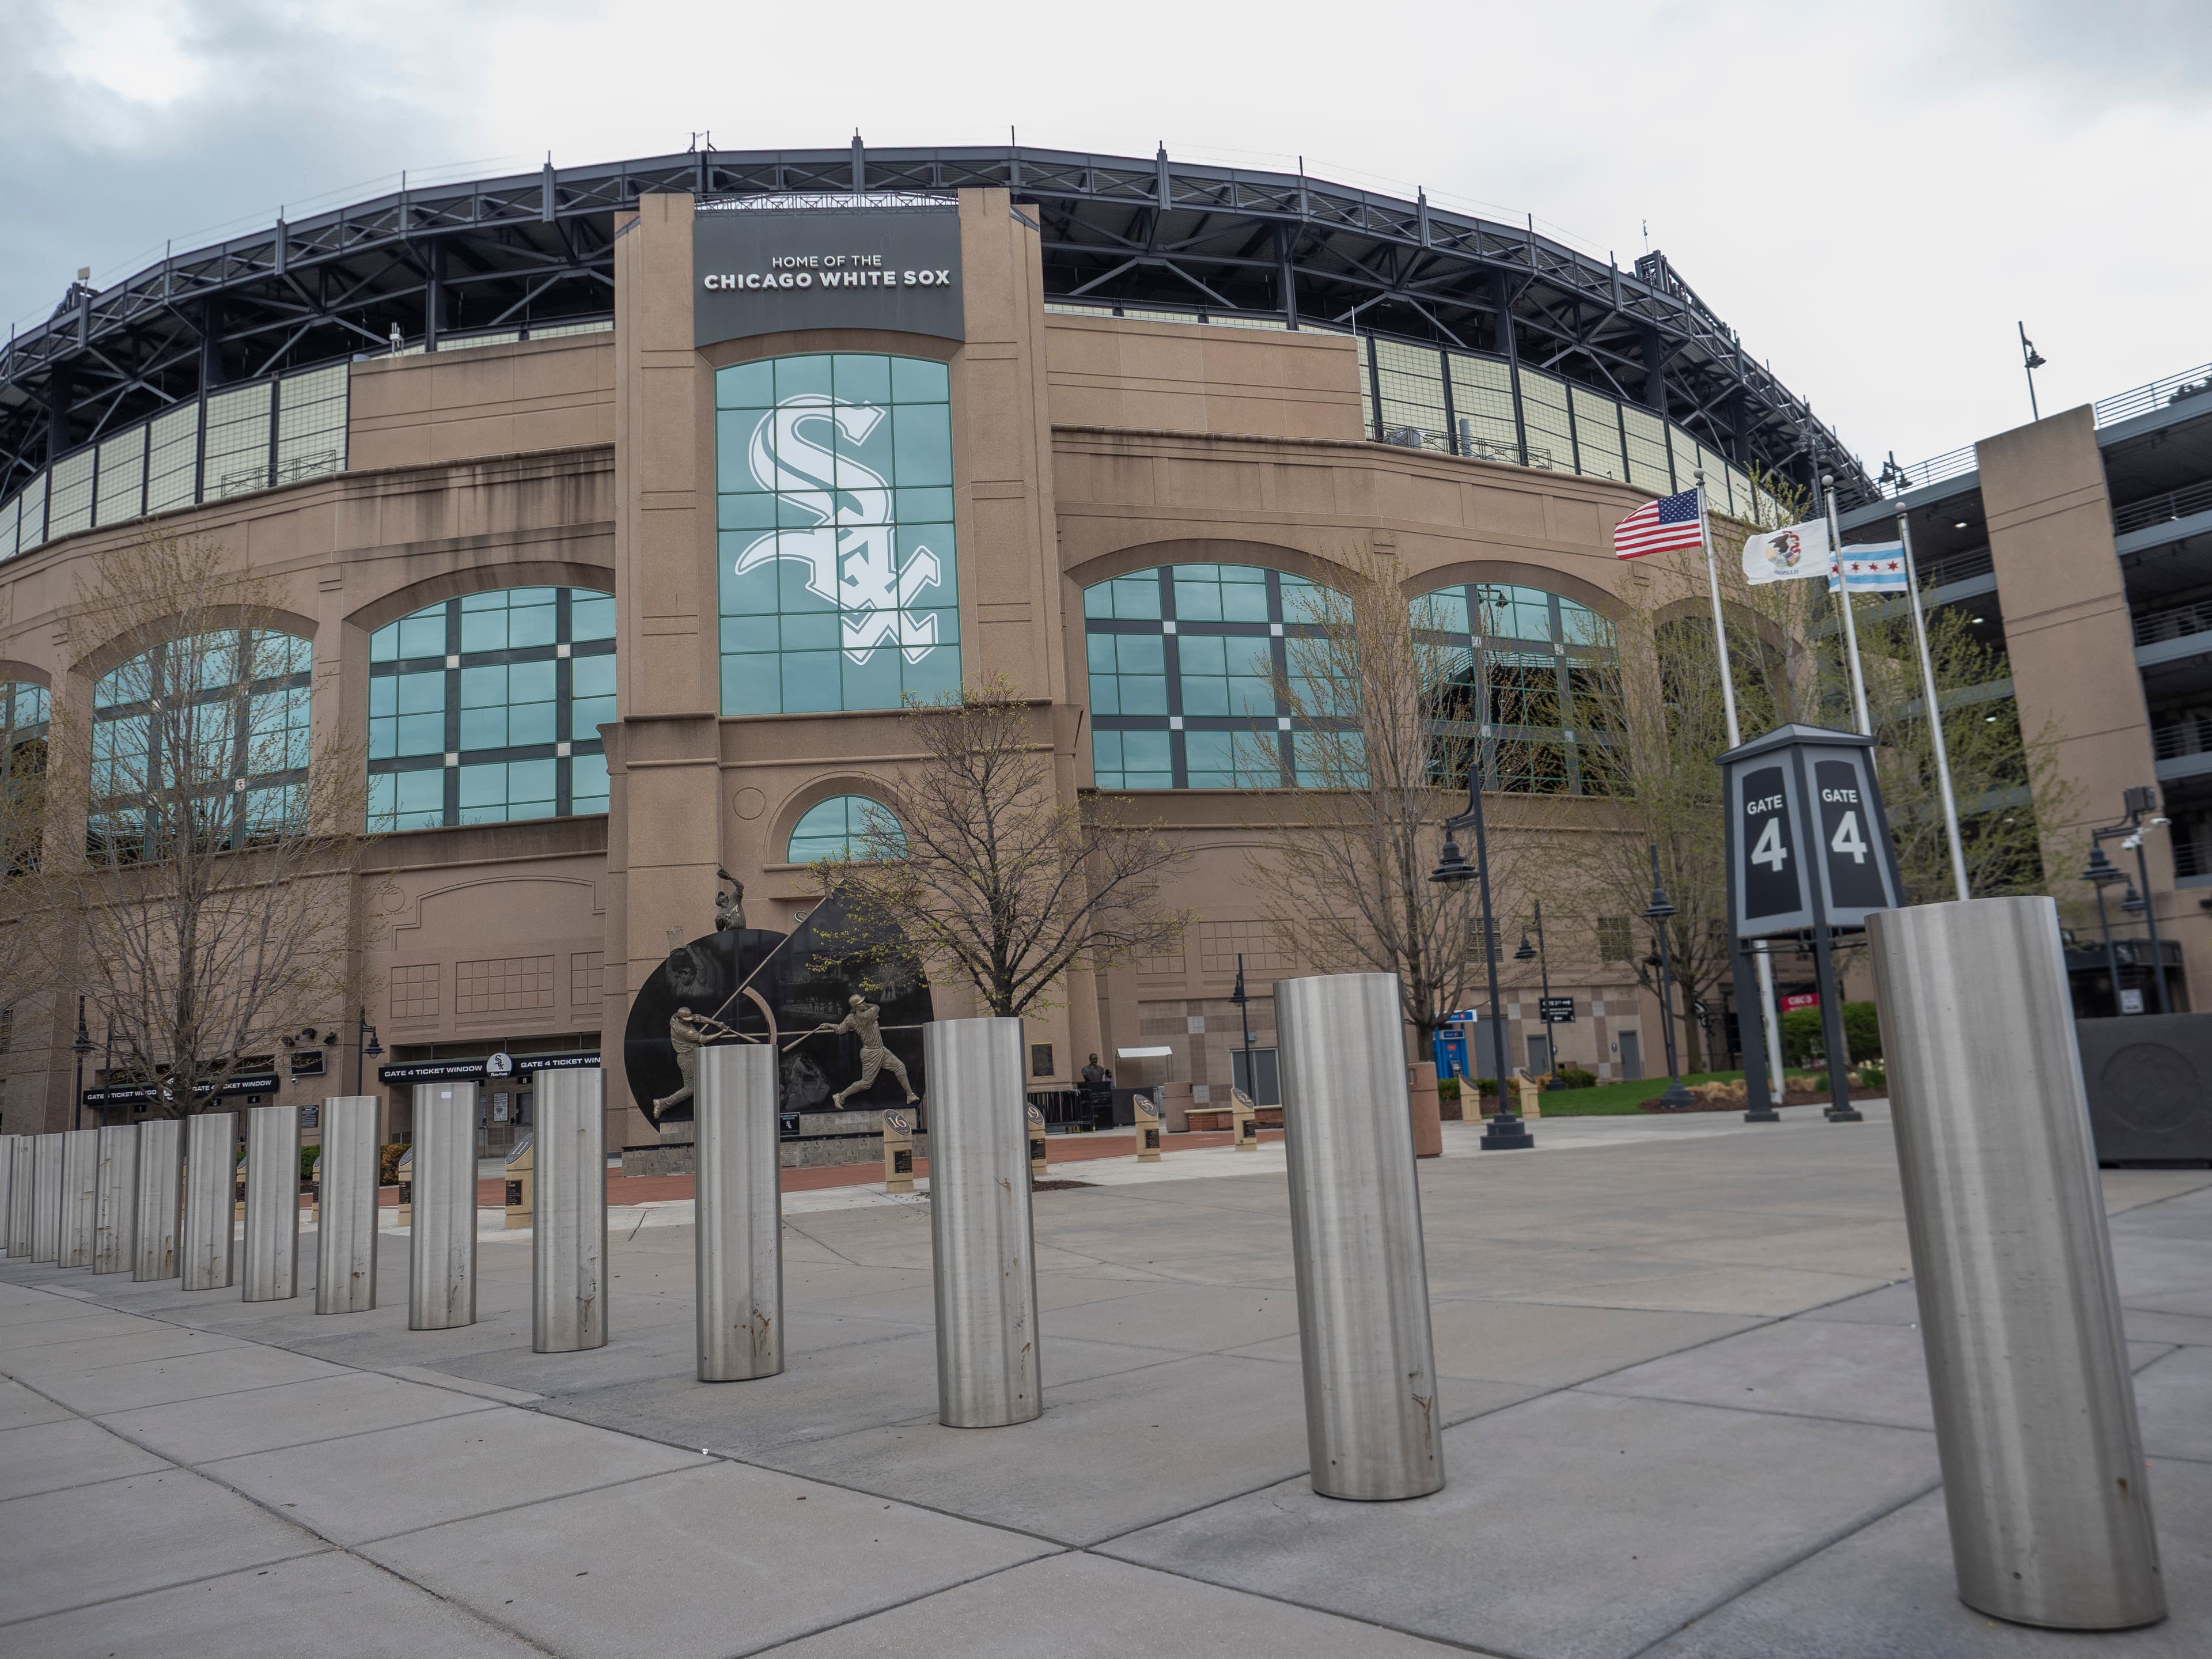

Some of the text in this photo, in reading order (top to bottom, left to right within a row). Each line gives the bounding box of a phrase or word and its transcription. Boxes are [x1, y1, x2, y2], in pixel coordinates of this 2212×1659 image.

[772, 255, 882, 268] HOME OF THE
[704, 270, 950, 290] CHICAGO WHITE SOX
[1822, 789, 1859, 804] GATE
[1747, 794, 1783, 815] GATE
[1751, 816, 1788, 872] 4
[1831, 810, 1869, 864] 4
[446, 1065, 483, 1073] WINDOW
[242, 1080, 272, 1088] WINDOW
[1138, 1100, 1154, 1111] 35
[887, 1114, 907, 1128] 16
[511, 1142, 529, 1155] 11
